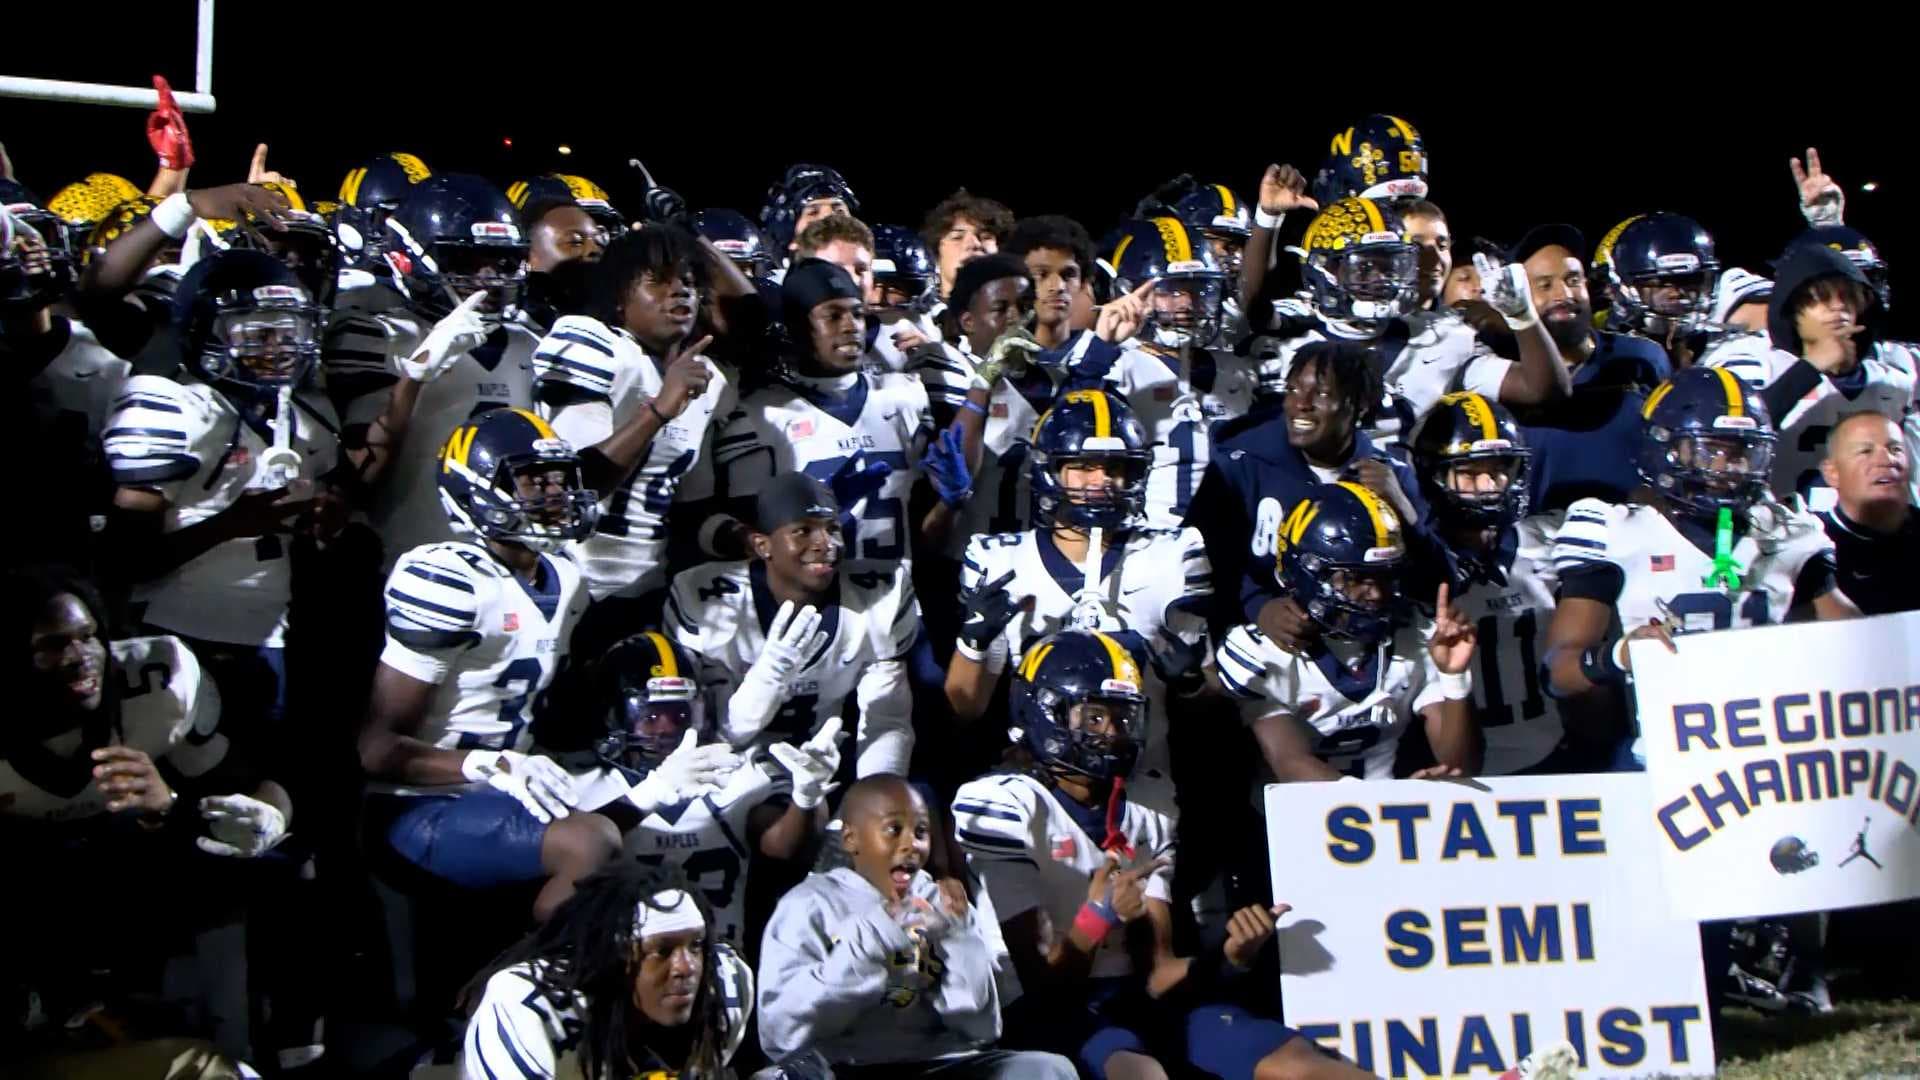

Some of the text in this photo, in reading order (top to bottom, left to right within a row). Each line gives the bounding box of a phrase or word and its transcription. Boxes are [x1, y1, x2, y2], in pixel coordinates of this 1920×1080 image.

[442, 424, 479, 474] N
[1283, 499, 1321, 546] N
[1476, 607, 1546, 728] 11
[1326, 797, 1607, 865] STATE
[1656, 748, 1920, 853] CHAMPIO
[1384, 902, 1596, 971] SEMI
